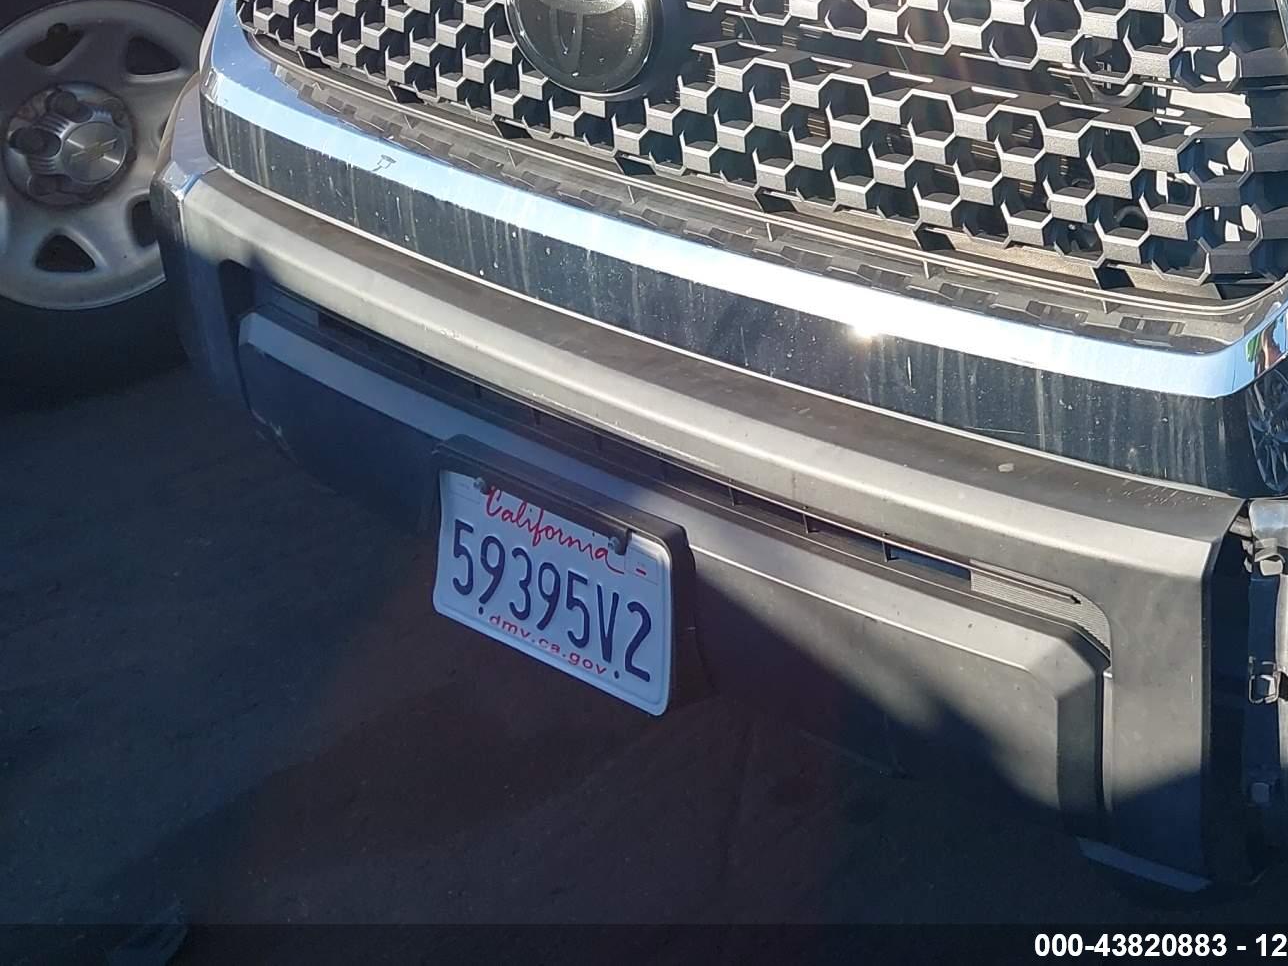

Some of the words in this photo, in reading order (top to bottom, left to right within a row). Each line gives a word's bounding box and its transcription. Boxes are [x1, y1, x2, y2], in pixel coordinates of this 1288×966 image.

[485, 486, 625, 575] California
[452, 518, 652, 683] 59395V2
[489, 613, 607, 675] dmv.ca.gov
